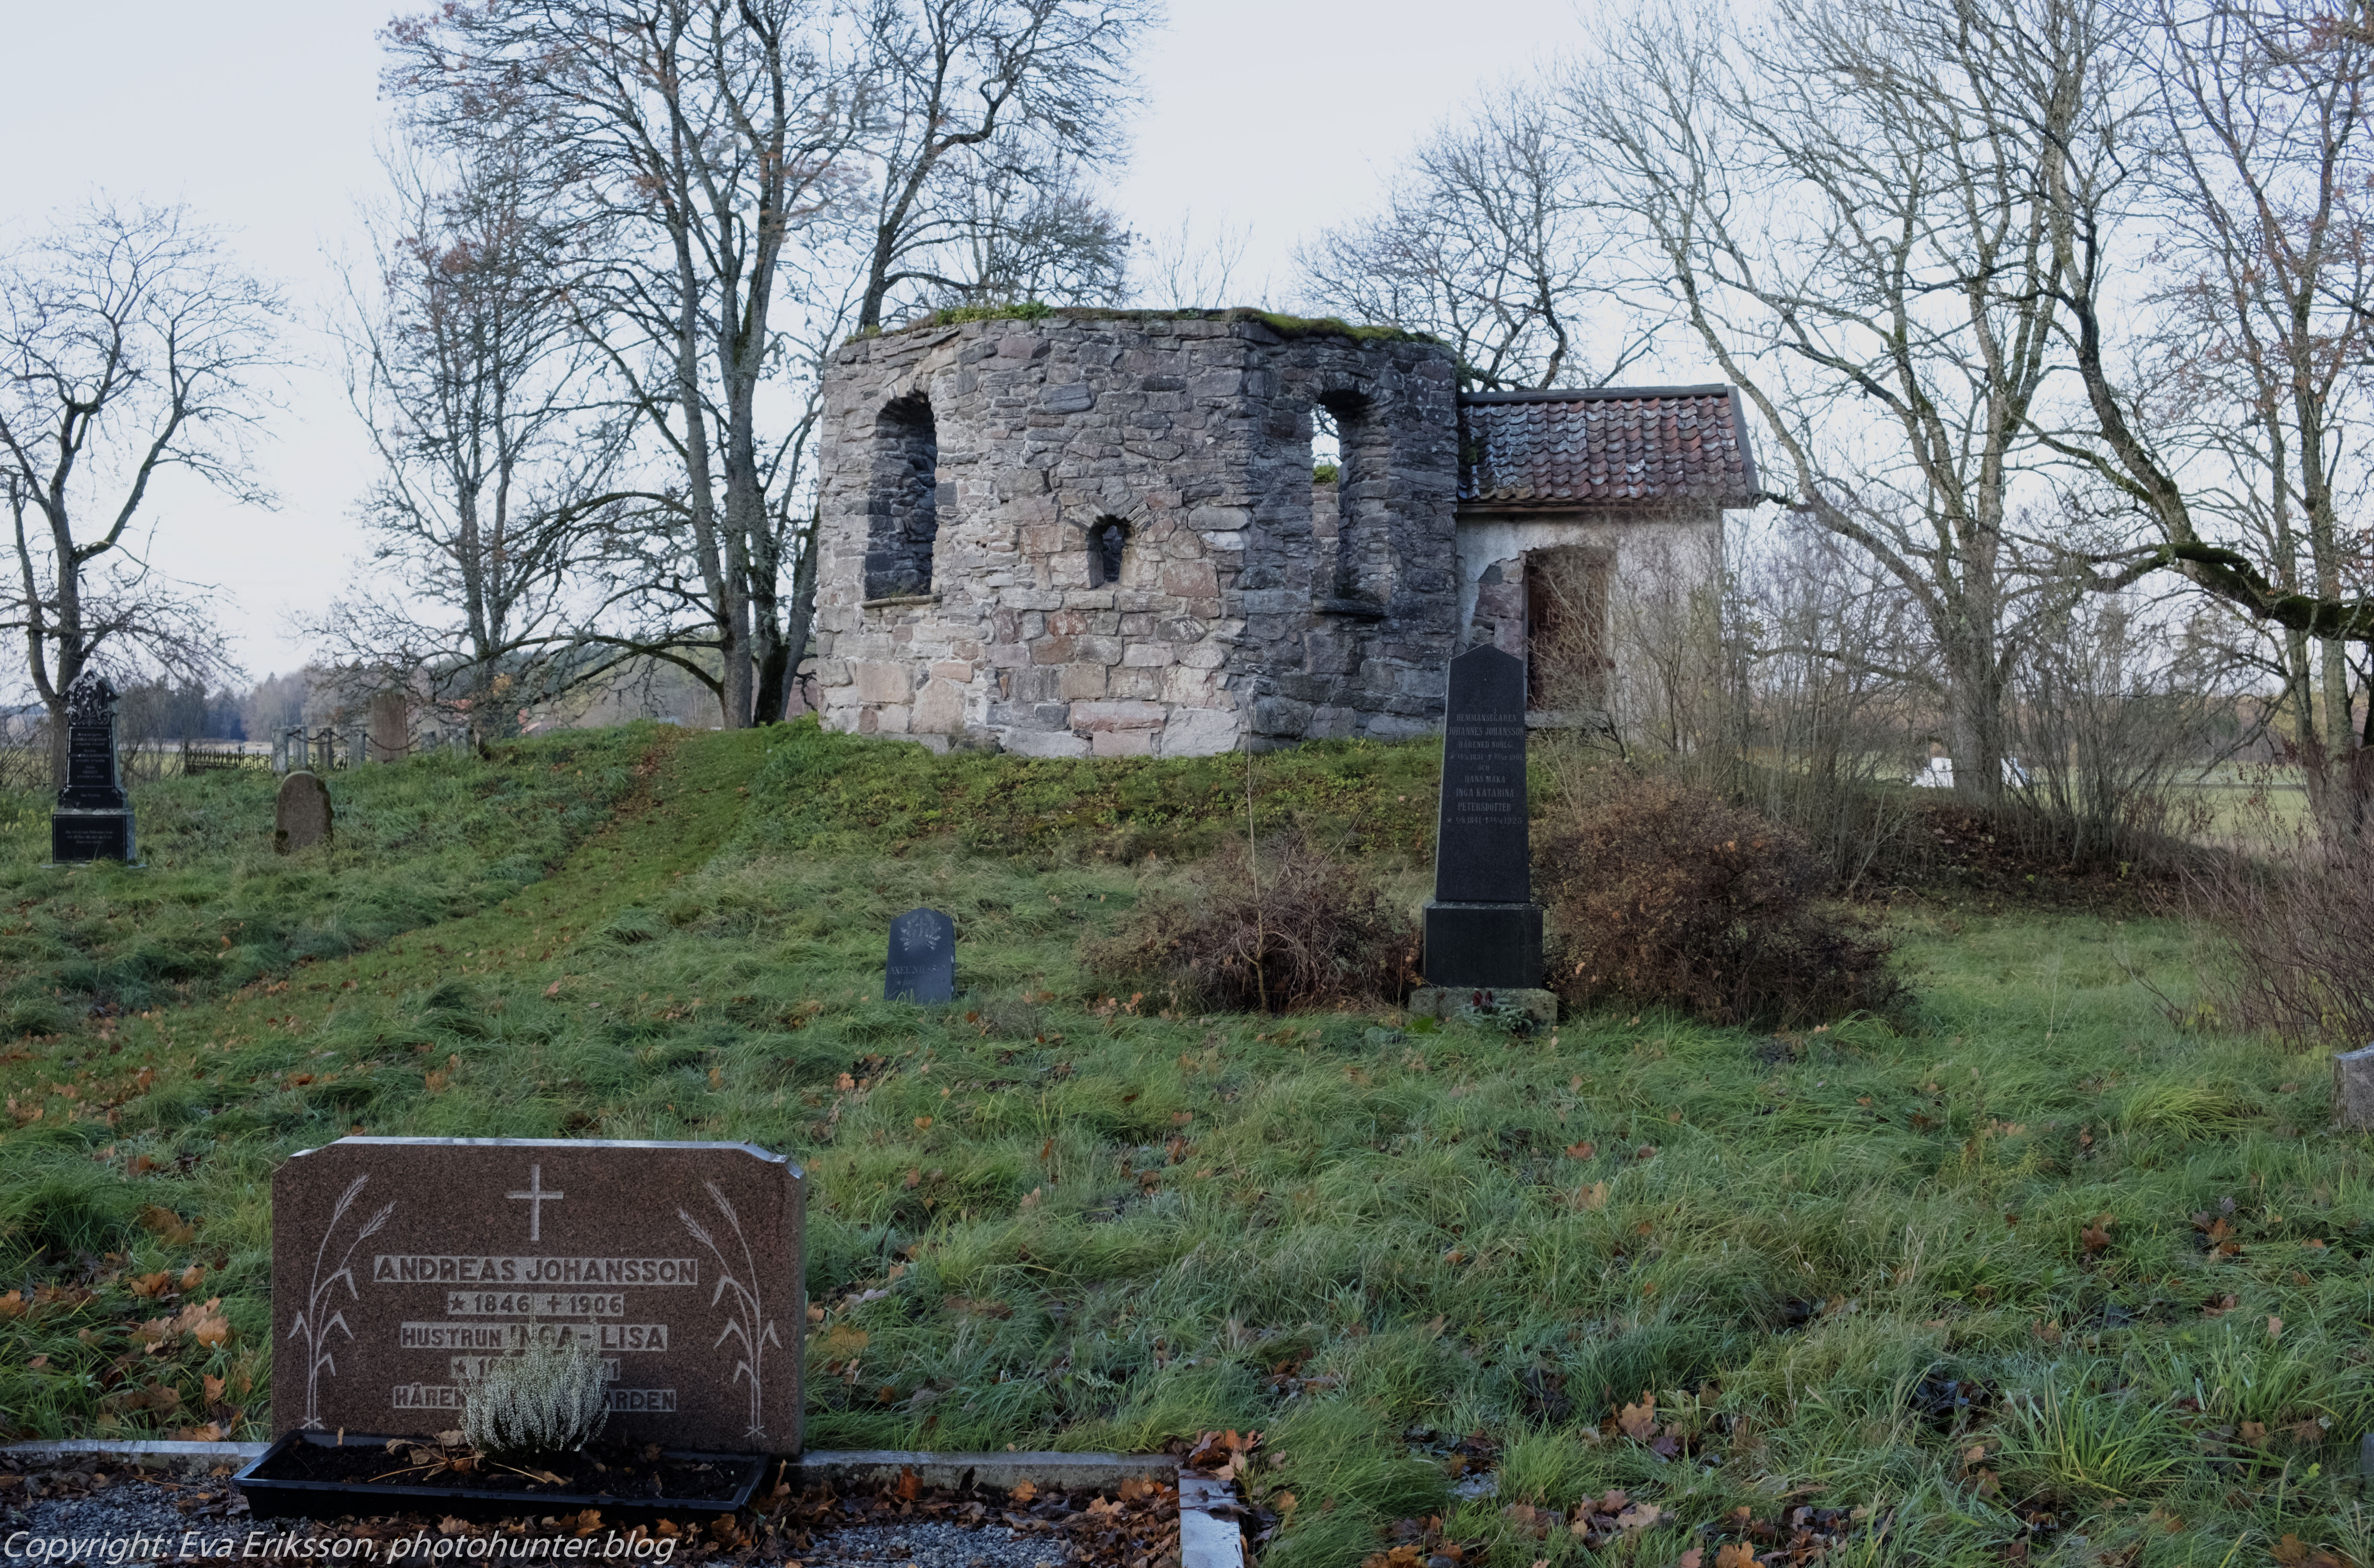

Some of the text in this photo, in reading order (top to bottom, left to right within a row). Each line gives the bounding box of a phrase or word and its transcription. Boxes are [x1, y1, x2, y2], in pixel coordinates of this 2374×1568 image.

[1448, 726, 1524, 736] JOHANNES JOHANSSON
[1459, 739, 1489, 748] HÄRENED
[1456, 788, 1514, 798] INGA KATARINA
[1458, 802, 1512, 812] PETERSDOTTER
[375, 1257, 696, 1283] ANDREAS JOHANSSON
[474, 1294, 622, 1314] 1846 1906
[402, 1327, 502, 1347] HUSTRUN
